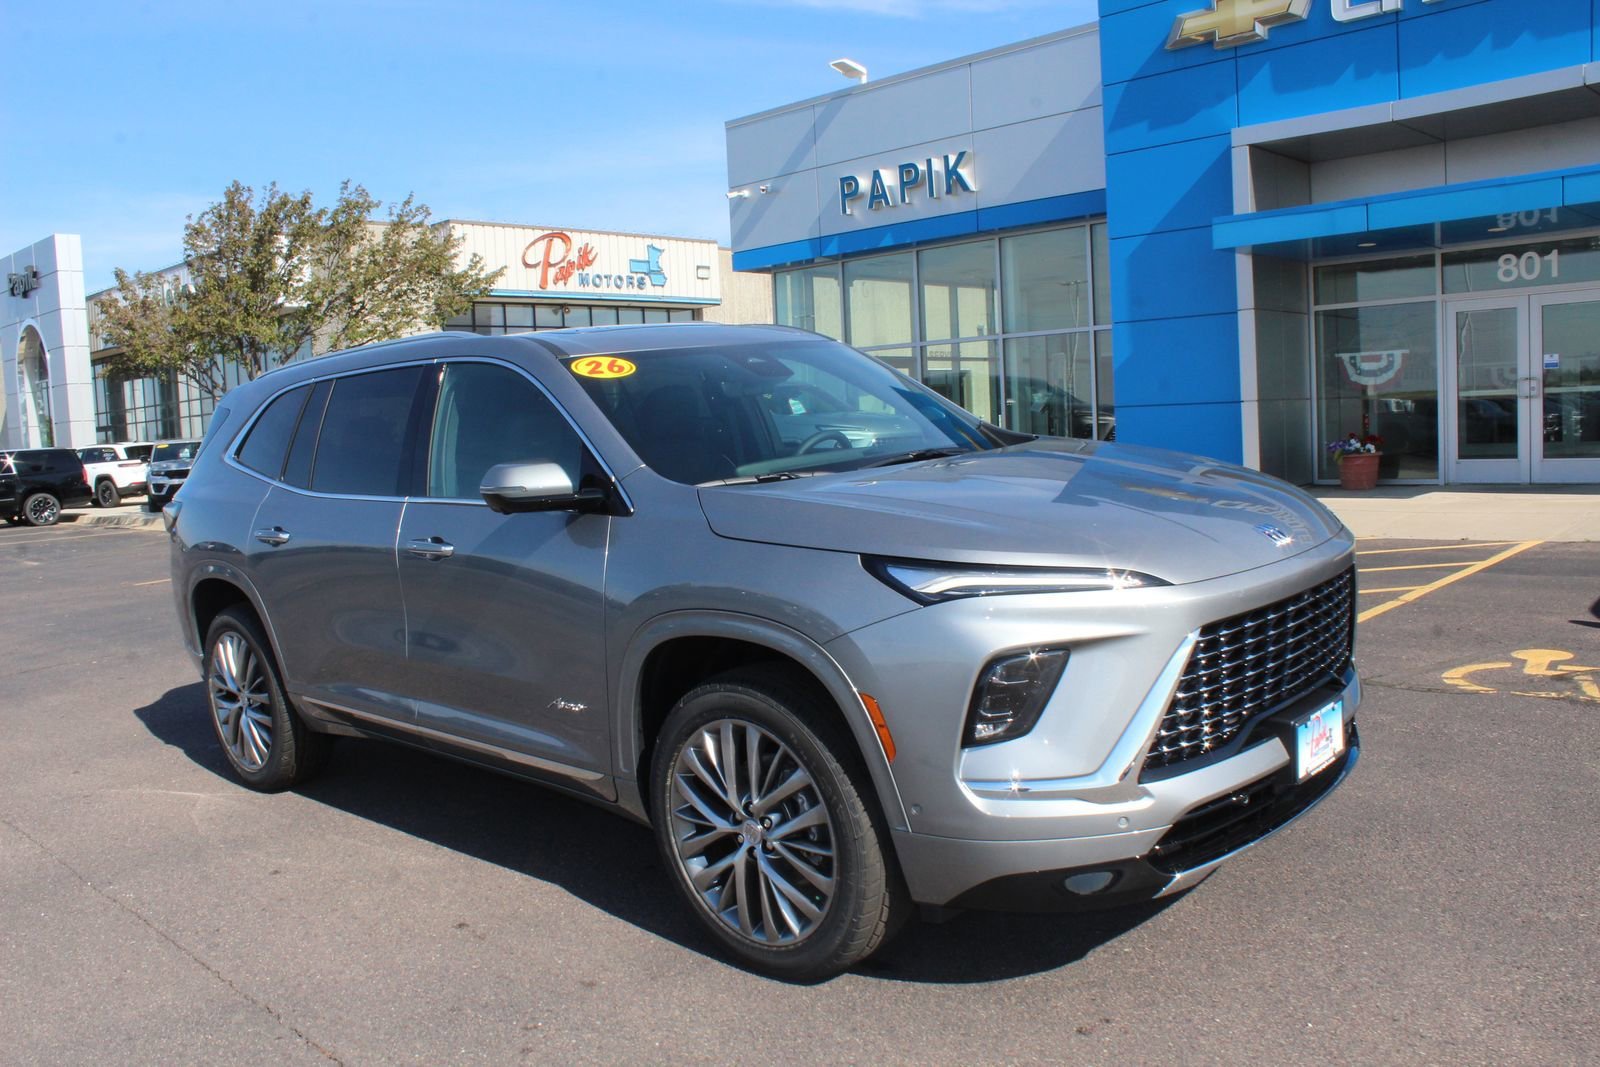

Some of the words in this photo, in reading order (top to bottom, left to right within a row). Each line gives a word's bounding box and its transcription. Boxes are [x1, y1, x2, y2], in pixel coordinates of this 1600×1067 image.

[839, 151, 977, 216] PAPIK
[521, 232, 598, 289] Papik
[1497, 248, 1559, 282] 801
[578, 272, 647, 290] MOTORS
[585, 359, 625, 375] 26
